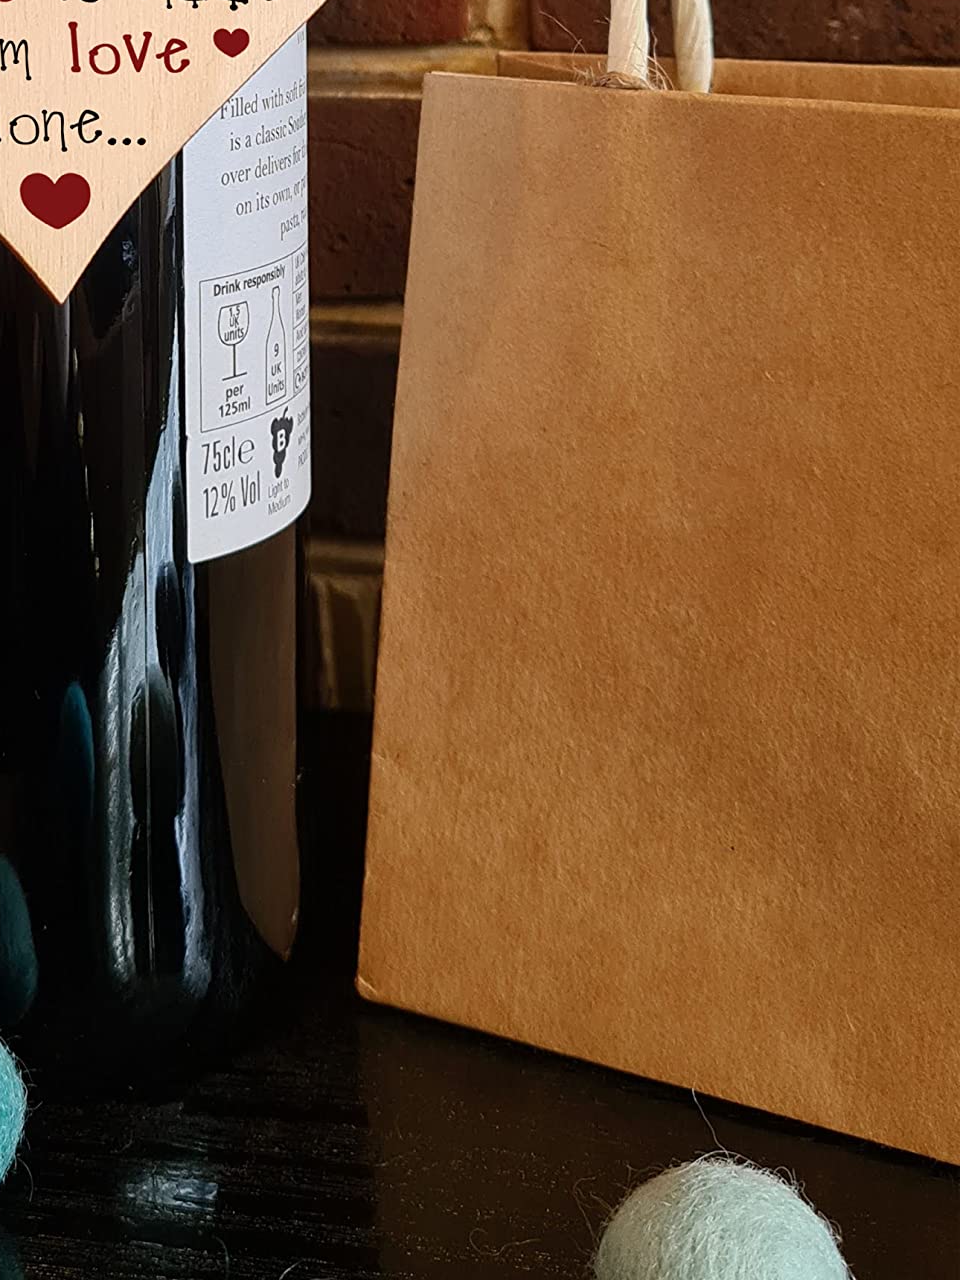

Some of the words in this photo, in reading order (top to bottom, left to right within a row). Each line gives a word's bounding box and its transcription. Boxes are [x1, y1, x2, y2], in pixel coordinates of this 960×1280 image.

[67, 21, 191, 75] love
[220, 94, 258, 119] Filled
[262, 88, 284, 111] with
[230, 132, 241, 151] is
[245, 134, 252, 148] a
[255, 120, 287, 146] classic
[221, 167, 251, 186] over
[254, 155, 292, 179] delivers
[236, 199, 252, 216] on
[256, 192, 270, 211] its
[213, 279, 241, 297] Drink
[243, 264, 286, 289] responsibly
[229, 316, 240, 328] UK
[224, 327, 244, 342] units
[273, 343, 280, 357] 9
[271, 361, 282, 376] UK
[225, 384, 244, 403] per
[268, 380, 285, 396] Units
[218, 397, 251, 418] 125ml
[277, 428, 286, 453] B
[203, 479, 237, 519] 12%
[240, 470, 261, 508] Vol
